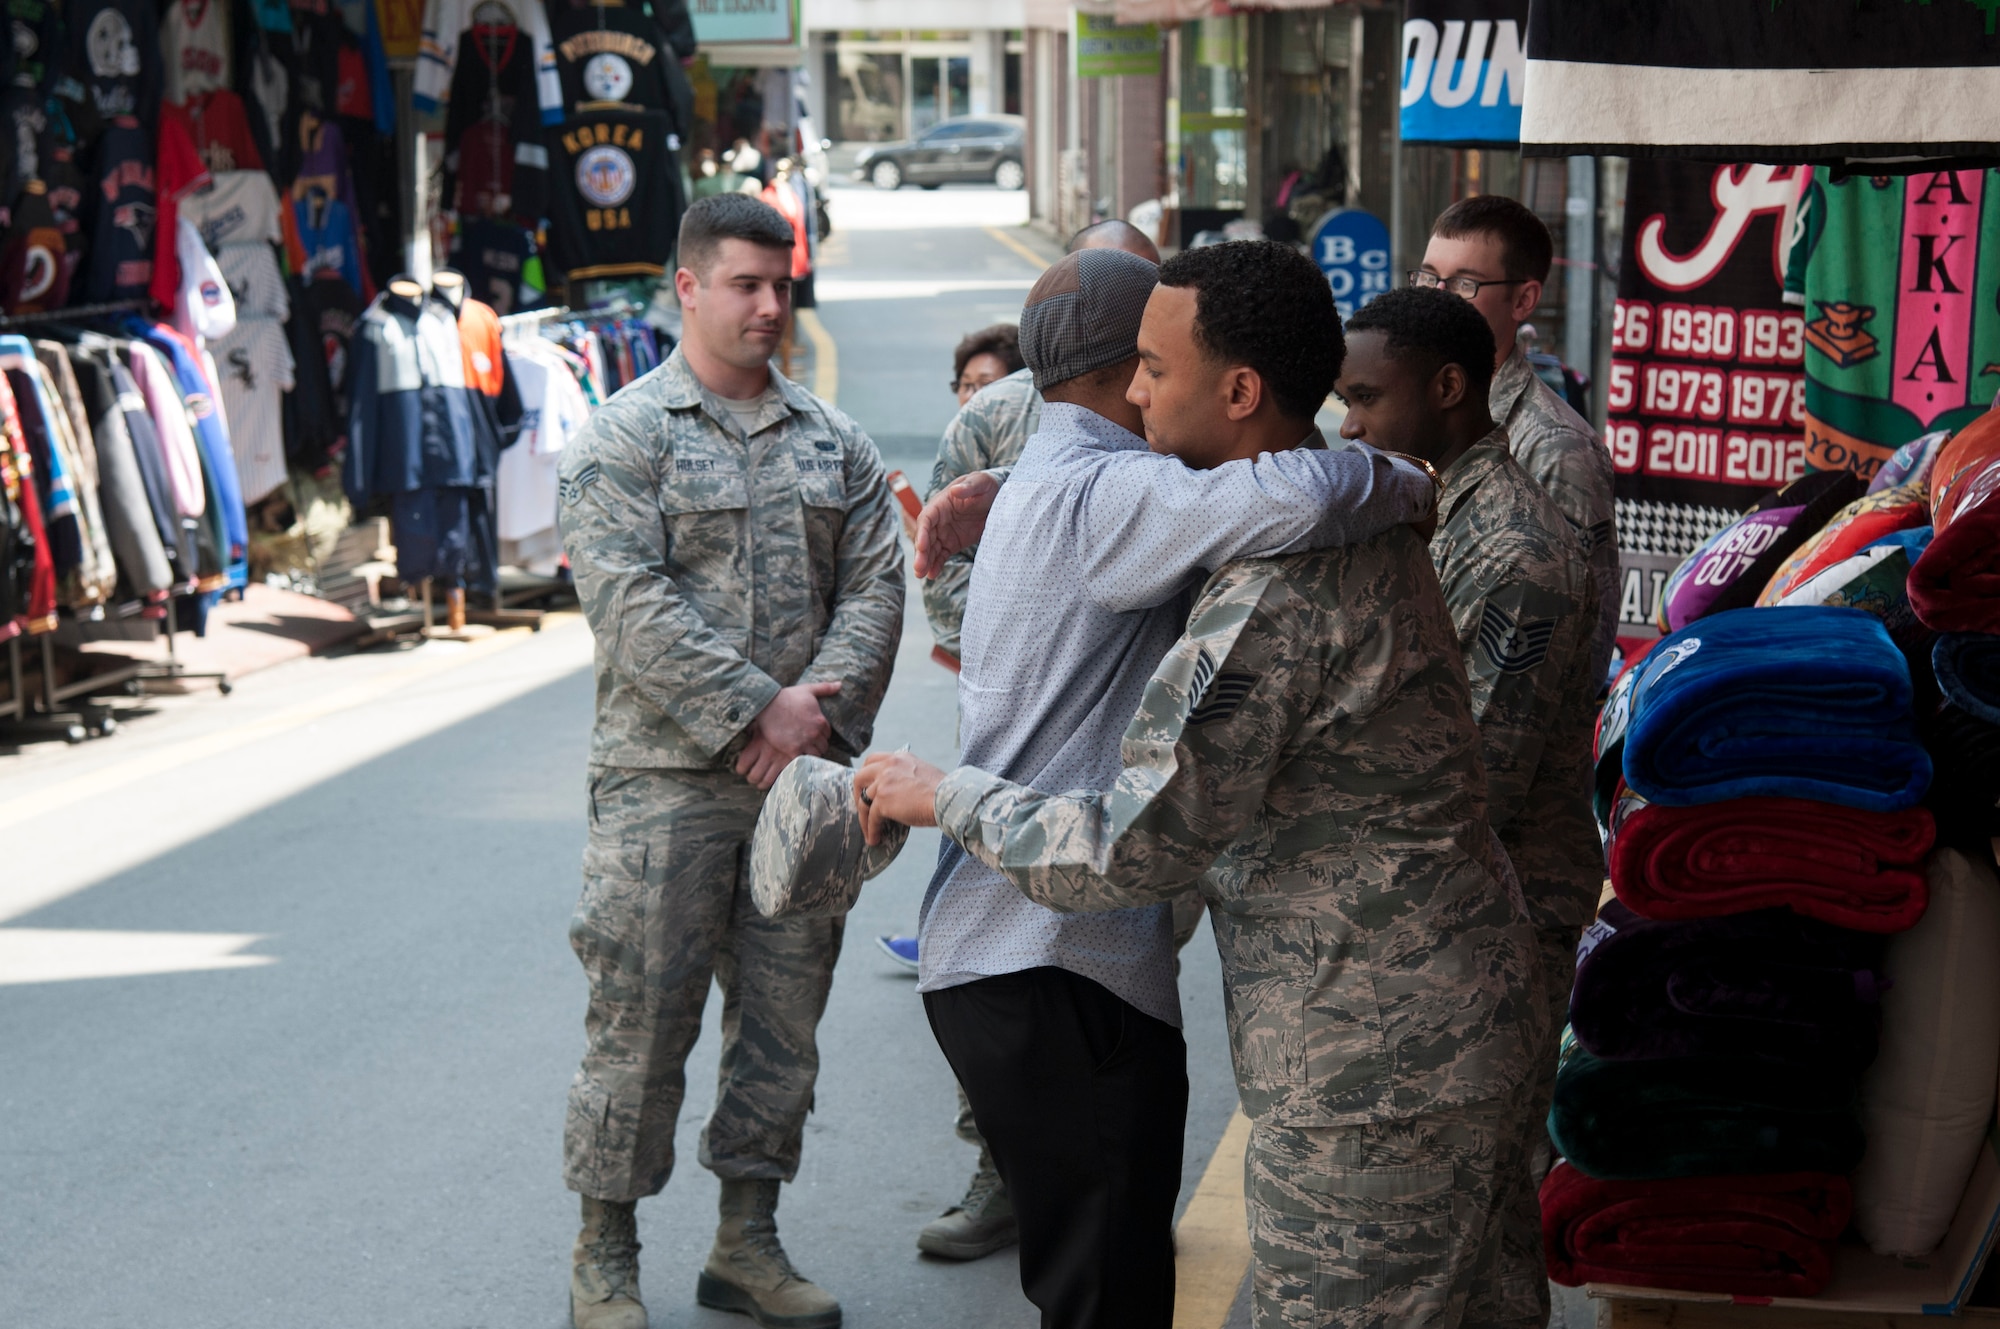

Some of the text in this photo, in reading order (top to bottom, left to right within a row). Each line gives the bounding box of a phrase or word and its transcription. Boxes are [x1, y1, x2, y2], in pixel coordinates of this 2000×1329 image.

[562, 123, 643, 154] KOREA
[586, 207, 631, 231] USA
[1661, 308, 1734, 355] 1930
[1646, 368, 1722, 415] 1973
[1733, 375, 1805, 421] 1978
[676, 460, 715, 472] HULSEY
[1649, 429, 1718, 475] 2011
[1726, 436, 1805, 482] 2012
